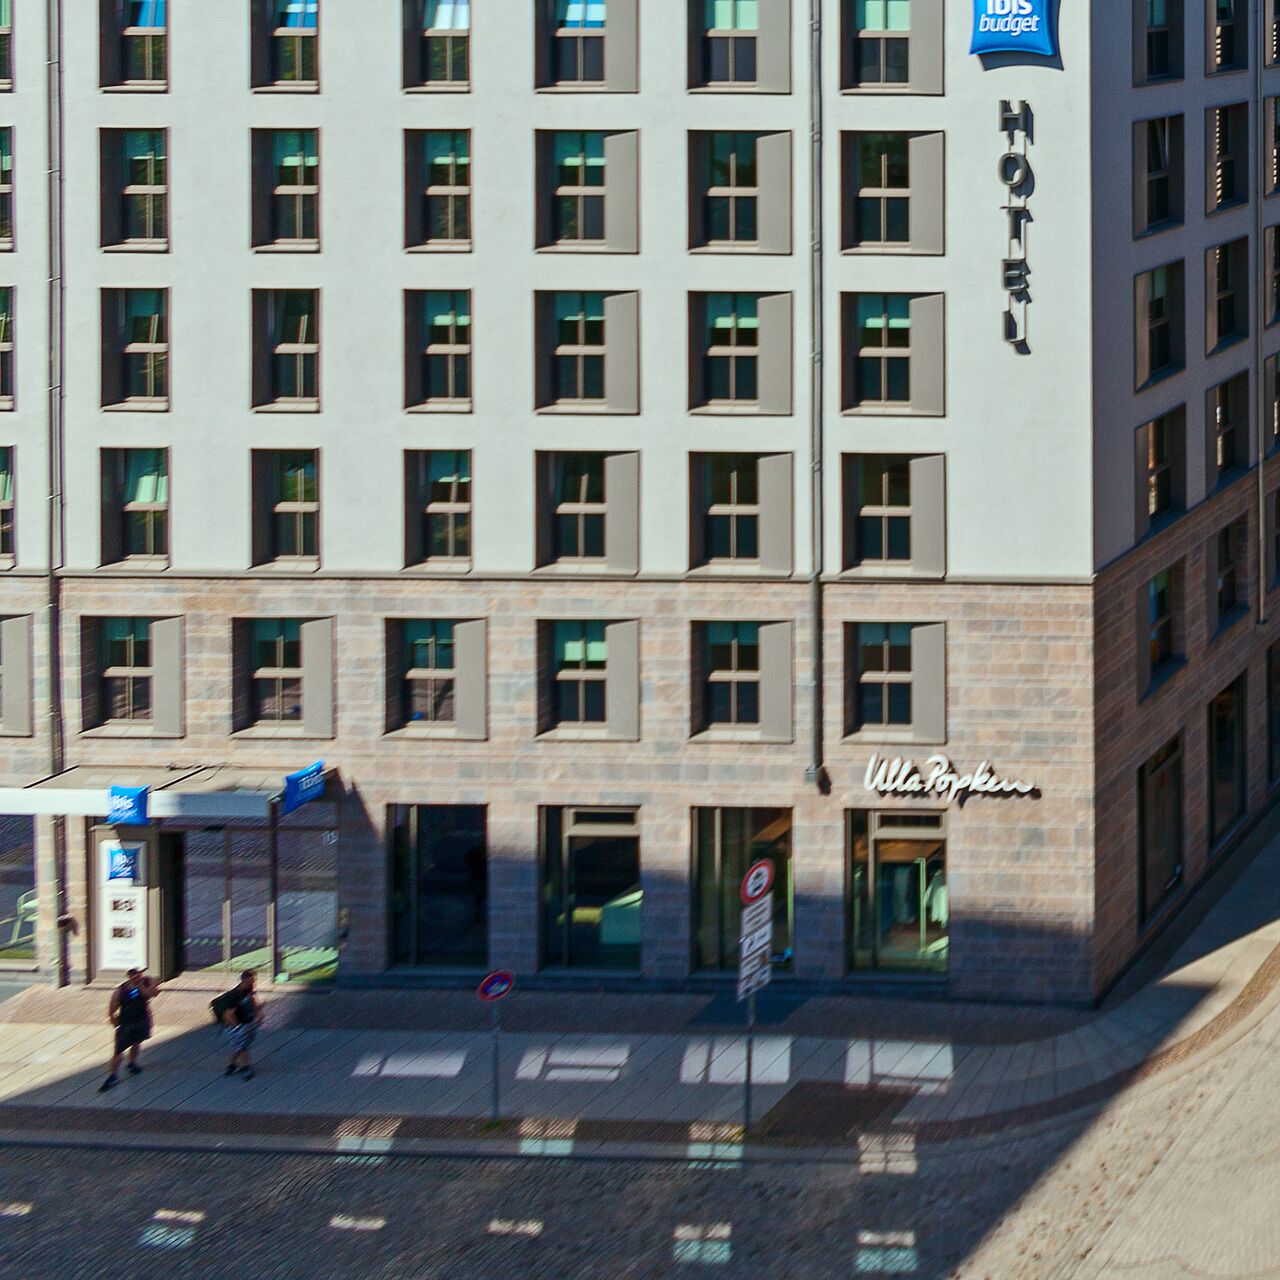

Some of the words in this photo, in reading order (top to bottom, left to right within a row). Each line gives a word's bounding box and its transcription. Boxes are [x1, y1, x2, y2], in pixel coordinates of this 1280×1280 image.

[979, 13, 1040, 36] budget
[998, 99, 1030, 344] HOTEL
[864, 753, 923, 792] Ulla
[924, 753, 1035, 803] Popken
